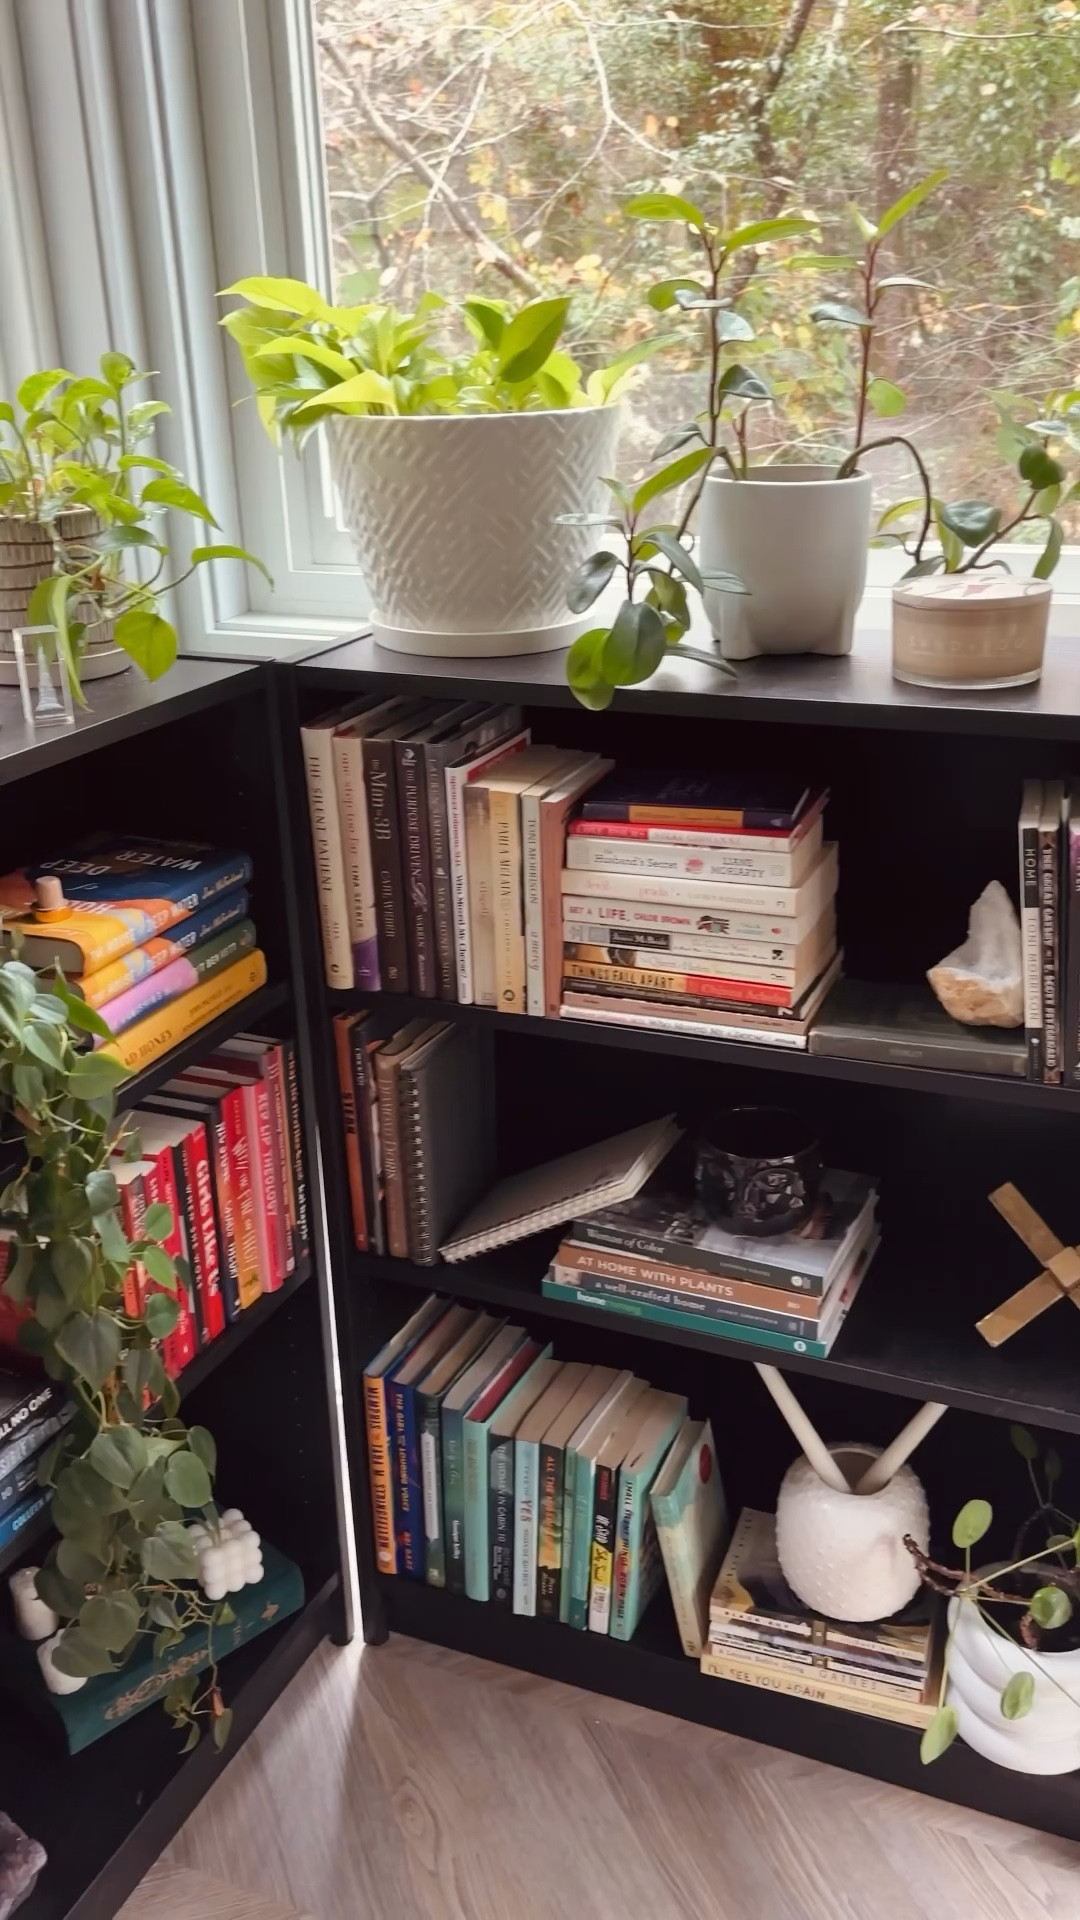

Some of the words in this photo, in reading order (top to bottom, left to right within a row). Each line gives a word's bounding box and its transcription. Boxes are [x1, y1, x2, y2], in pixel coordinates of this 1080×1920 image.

[307, 755, 321, 779] THE
[368, 770, 389, 808] Man
[310, 786, 328, 832] SILENT
[405, 784, 419, 832] PURPOSE
[372, 815, 392, 841] 3B
[527, 818, 536, 844] TONI
[40, 858, 112, 876] DEEP
[116, 850, 201, 871] WATER
[316, 838, 334, 894] PATIENT
[408, 834, 421, 877] DRIVEN
[1024, 848, 1036, 887] HOME
[527, 846, 538, 904] MORRISON
[1042, 872, 1052, 905] GREAT
[1025, 917, 1037, 947] TONI
[1042, 907, 1053, 945] GATSBY
[608, 969, 639, 984] FALL
[639, 973, 674, 989] APART
[1026, 953, 1040, 1021] MORRISON
[1044, 975, 1054, 1004] SCOTT
[256, 1092, 269, 1120] RED
[194, 1158, 213, 1216] Girls
[261, 1151, 278, 1216] THEOLOGY
[200, 1217, 218, 1265] Like
[623, 1237, 635, 1249] of
[634, 1238, 665, 1255] Color
[575, 1253, 594, 1267] AT
[596, 1258, 638, 1277] HOME
[638, 1267, 677, 1285] WITH
[677, 1275, 734, 1298] PLANTS
[575, 1289, 607, 1307] home
[593, 1280, 602, 1289] a
[602, 1279, 671, 1304] well-crafted
[672, 1295, 707, 1312] home
[10, 1407, 30, 1428] NO
[28, 1387, 53, 1412] ONE
[366, 1386, 382, 1430] MEMPHIS
[372, 1443, 382, 1466] TARA
[546, 1456, 554, 1472] ALL
[496, 1495, 507, 1505] IN
[624, 1480, 633, 1505] SMALL
[373, 1482, 390, 1548] STRINGFELLOW
[496, 1506, 507, 1532] CABIN
[519, 1499, 532, 1522] YES
[496, 1533, 505, 1542] 10
[728, 1669, 749, 1682] SEE
[753, 1674, 782, 1689] YOU
[818, 1668, 878, 1691] GAINES
